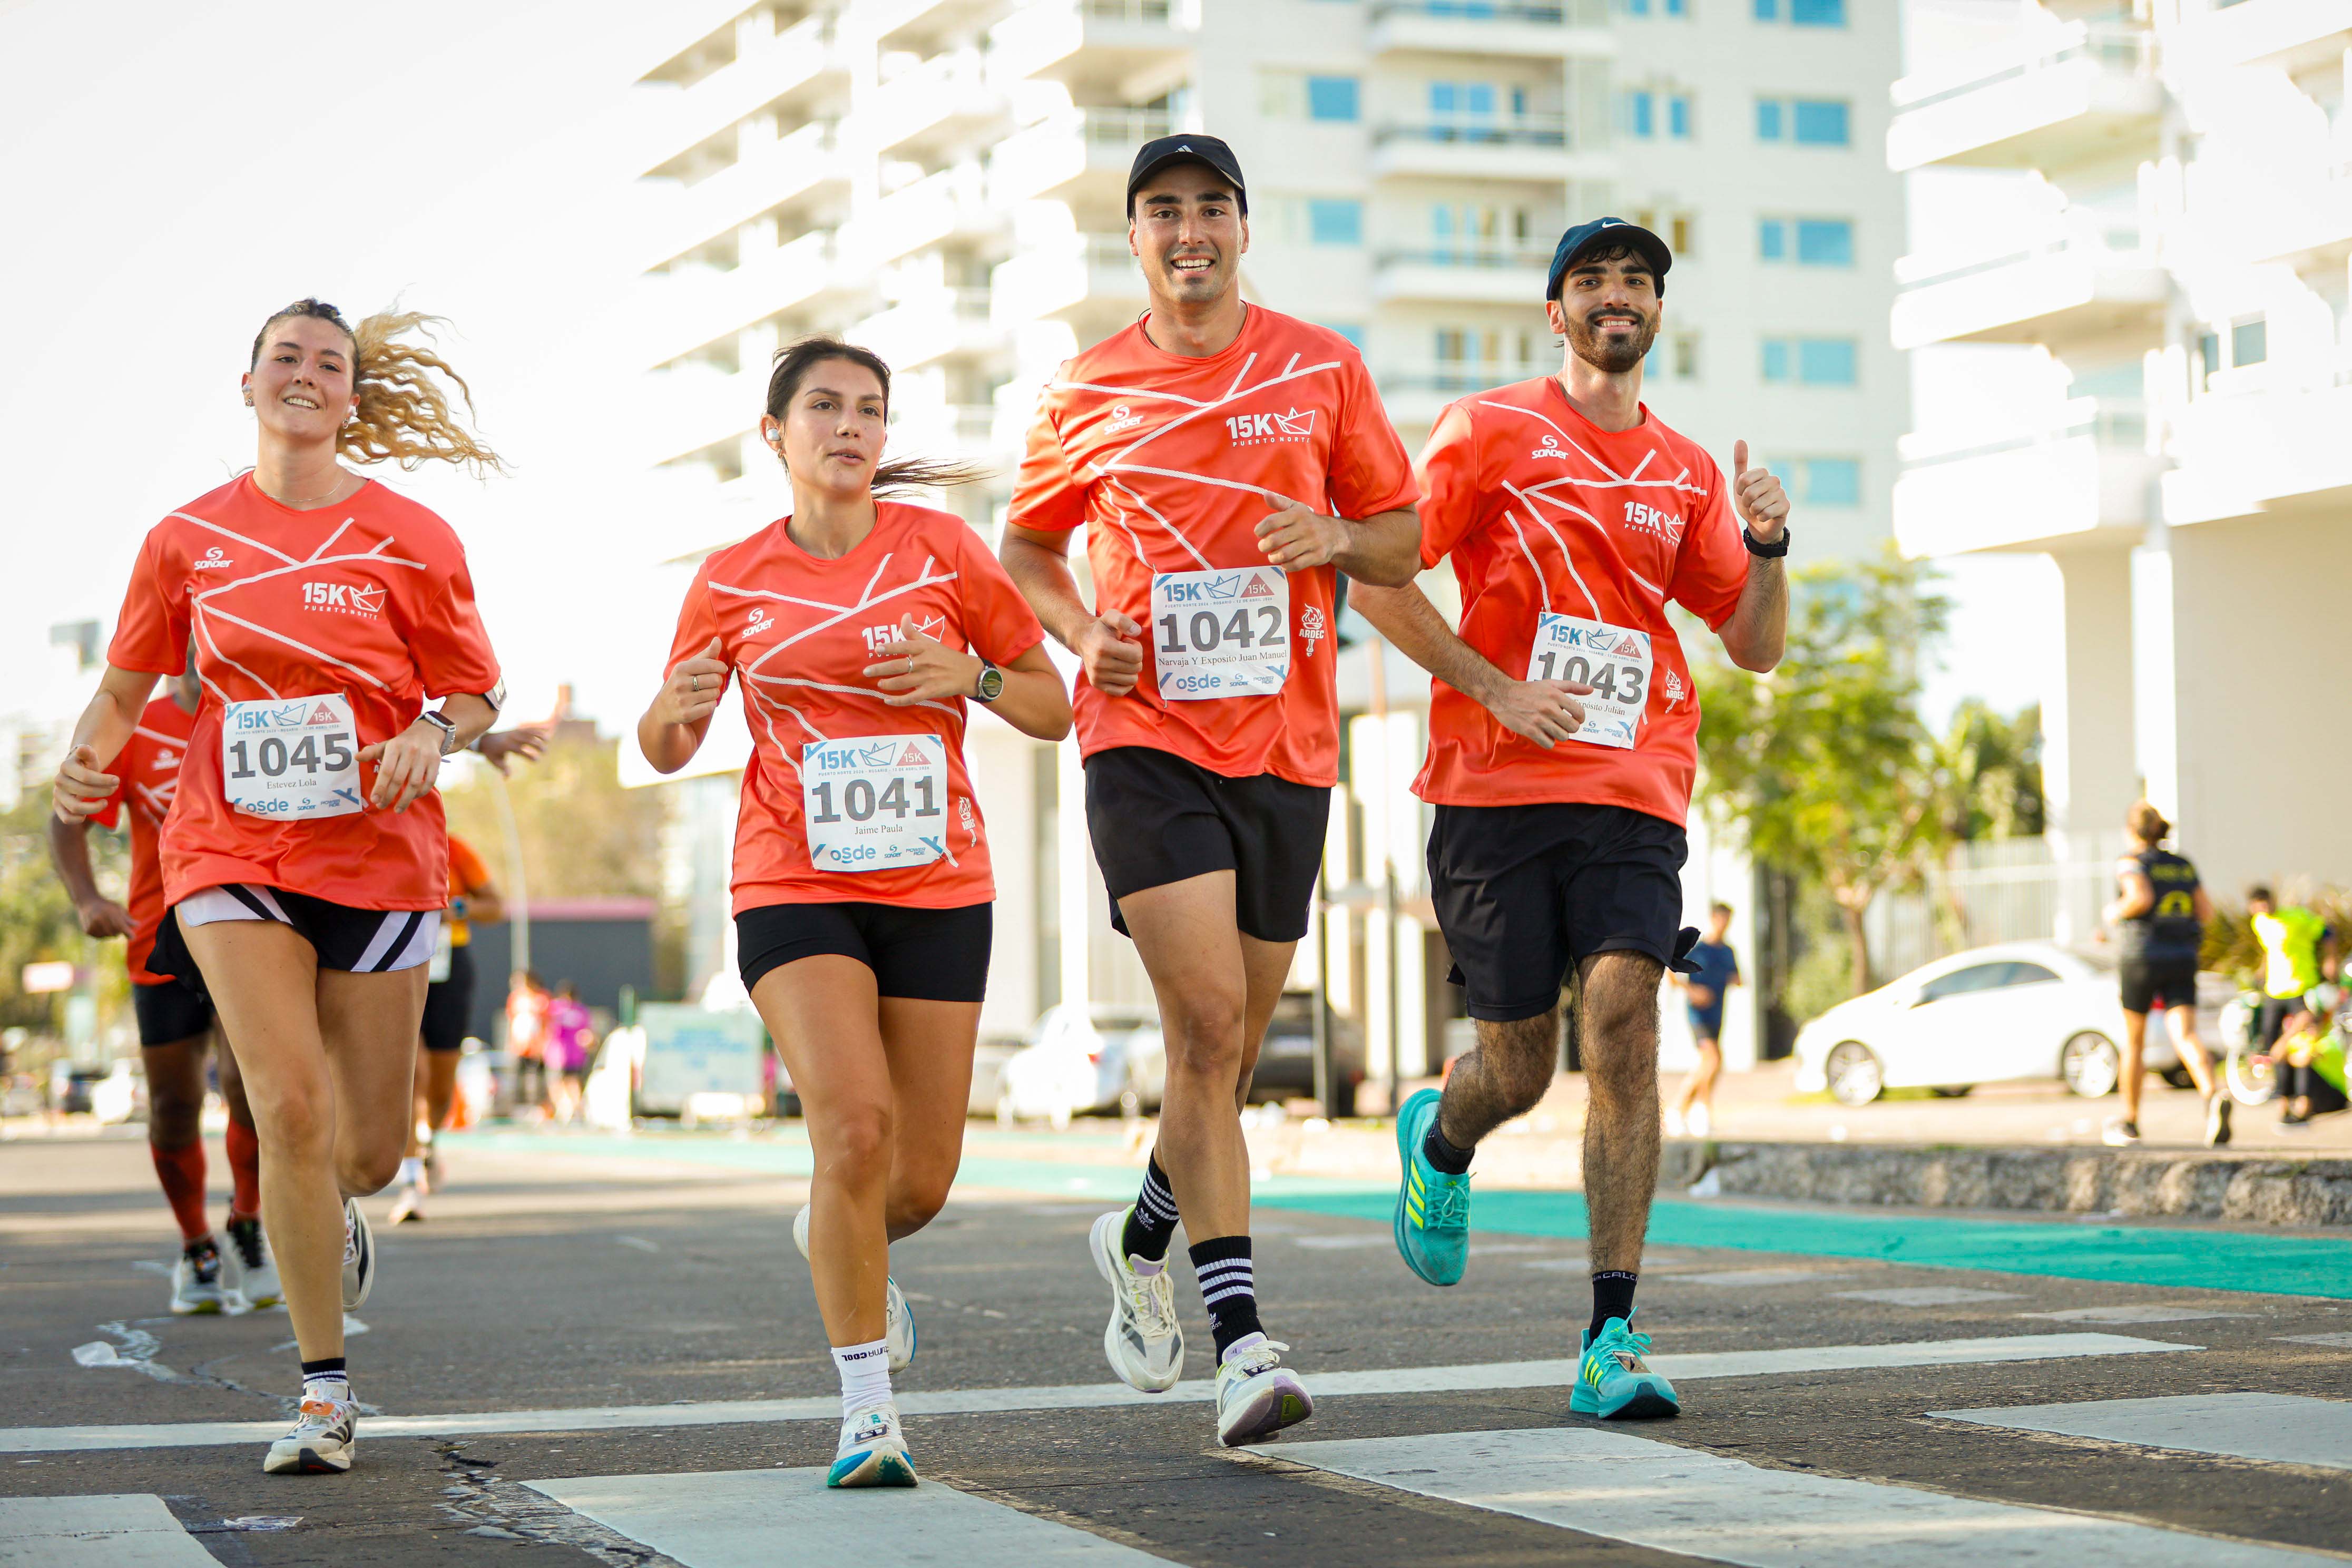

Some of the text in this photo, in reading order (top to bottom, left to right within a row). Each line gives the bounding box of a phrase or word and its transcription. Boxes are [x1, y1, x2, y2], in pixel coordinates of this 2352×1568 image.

[1226, 413, 1275, 439] 15K
[1233, 437, 1275, 447] PUERTO
[1624, 501, 1662, 531] 15K
[1624, 523, 1661, 538] PUERTO
[302, 582, 348, 606] 15K
[1163, 582, 1202, 602] 15K
[1248, 584, 1267, 594] 15K
[304, 605, 378, 620] PUERTO NORTE
[861, 624, 907, 650] 15K
[1159, 605, 1285, 653] 1042
[1299, 629, 1324, 639] ARDEC
[1550, 624, 1583, 645] 15K
[1620, 644, 1636, 654] 15K
[1159, 658, 1189, 667] Narvaja
[1239, 653, 1257, 662] Juan
[1260, 650, 1287, 660] Manuel
[1176, 673, 1221, 691] osde
[1534, 651, 1644, 704] 1043
[1666, 689, 1684, 700] ARDEC
[314, 711, 333, 721] 15K
[1573, 699, 1625, 716] pósito Julián
[237, 710, 270, 729] 15K
[230, 732, 352, 779] 1045
[817, 749, 857, 770] 15K
[904, 752, 923, 762] 15K
[267, 778, 317, 790] Estevez Lola
[246, 797, 289, 814] osde
[812, 776, 940, 824] 1041
[855, 824, 903, 835] Jaime Paula
[830, 844, 876, 863] osde
